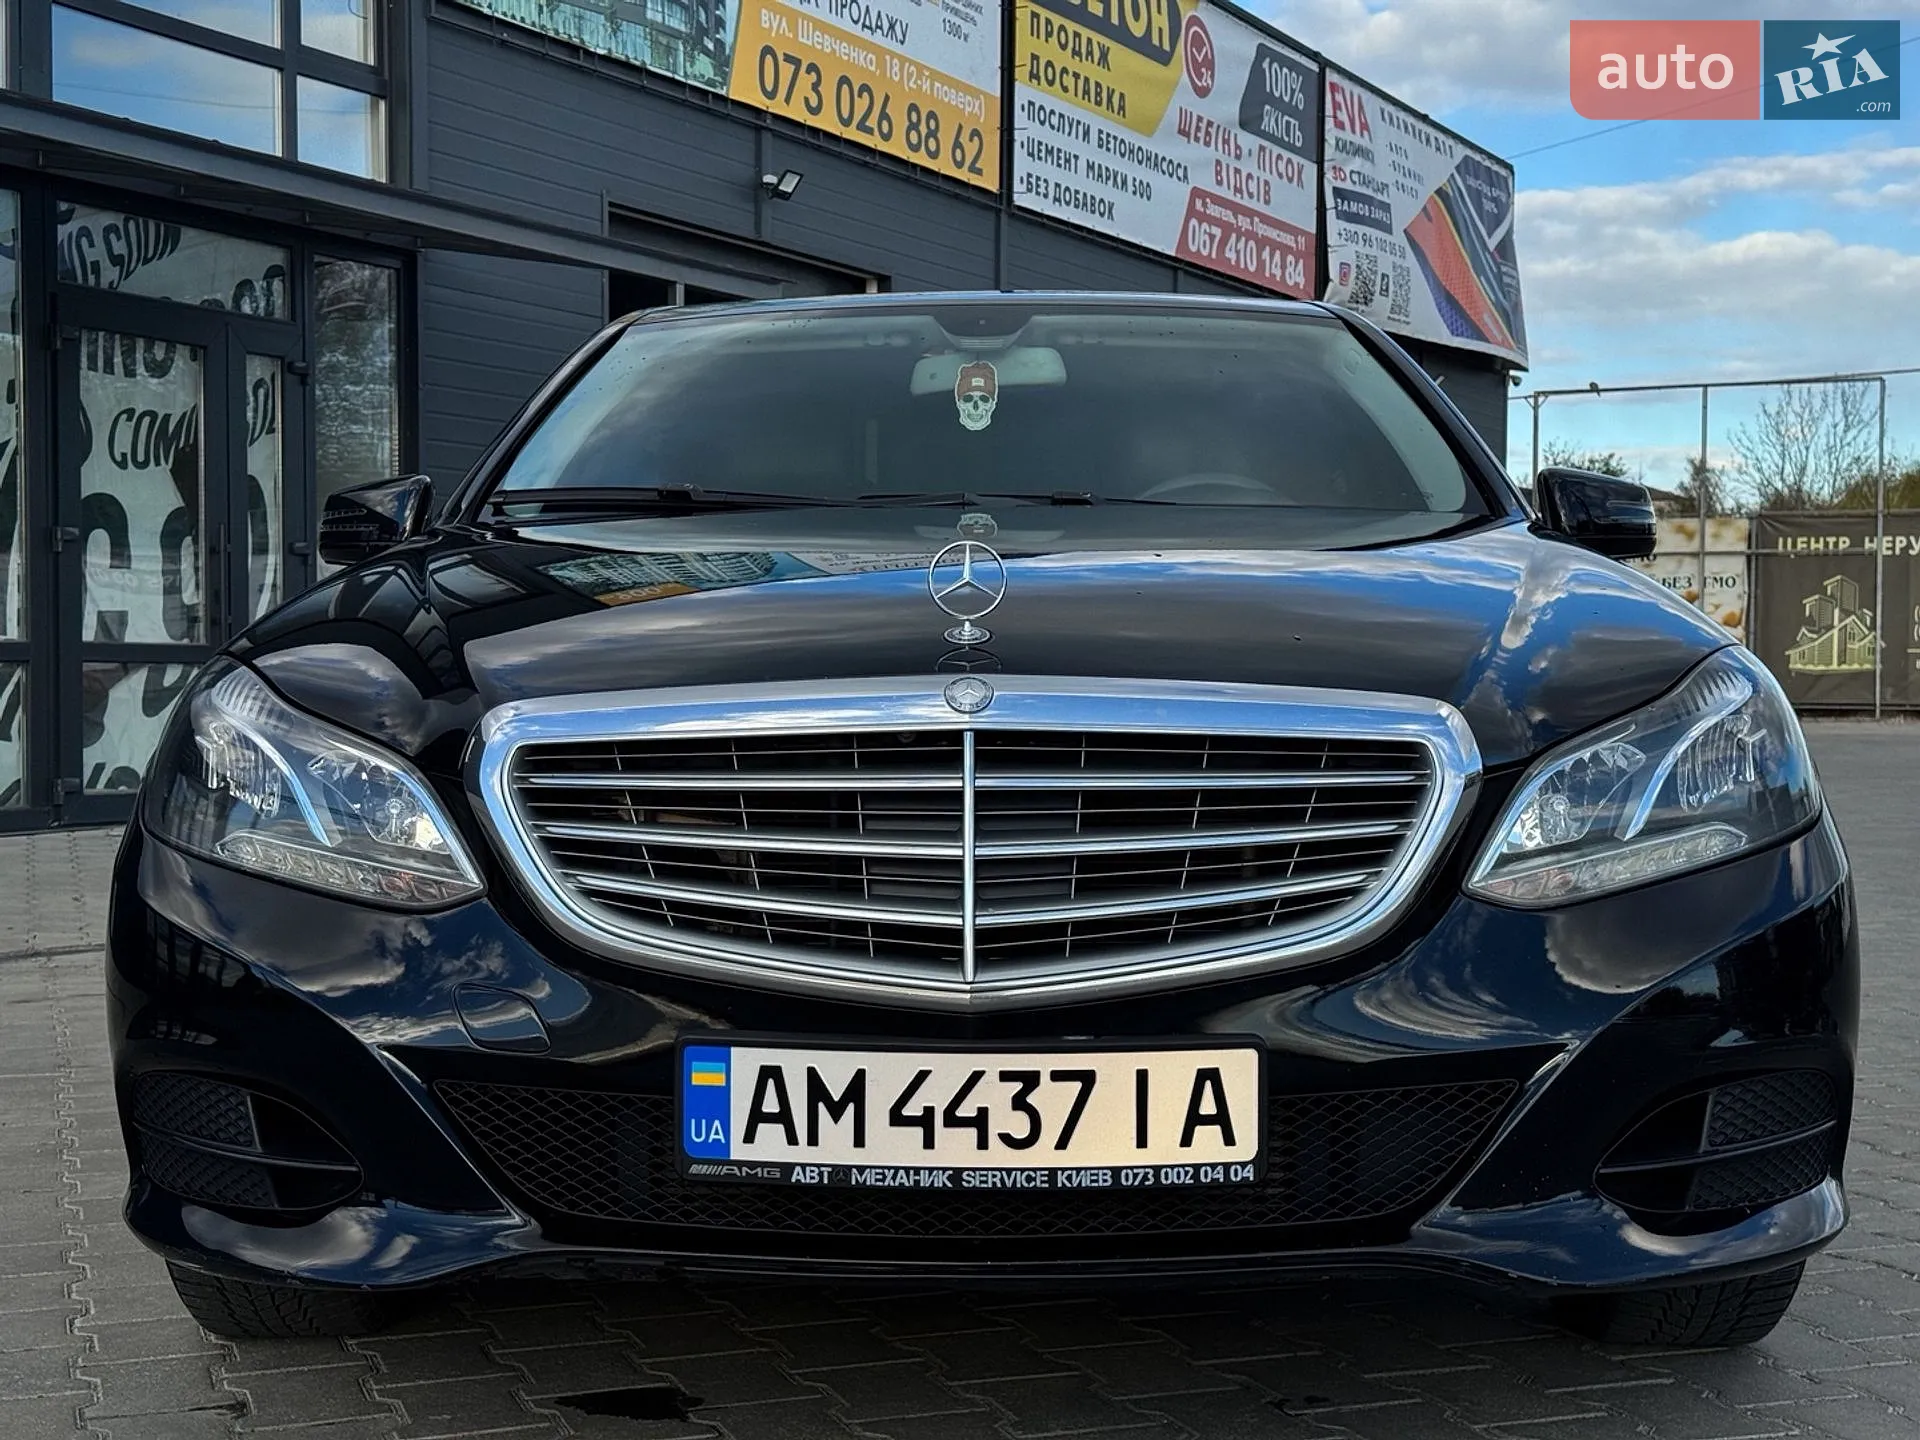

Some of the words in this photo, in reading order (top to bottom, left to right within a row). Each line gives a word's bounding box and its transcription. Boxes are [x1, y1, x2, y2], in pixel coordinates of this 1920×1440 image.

[761, 8, 793, 38] вул.
[798, 18, 880, 76] Шевченка,
[885, 54, 900, 82] 18
[903, 62, 931, 96] (2-й
[933, 81, 985, 123] поверх)
[1030, 10, 1112, 73] ПРОДАЖ
[1028, 52, 1127, 119] ДОСТАВКА
[1200, 67, 1212, 89] 24
[1261, 56, 1305, 111] 100%
[758, 44, 823, 116] 073
[835, 74, 893, 142] 026
[905, 102, 941, 160] 88
[951, 122, 984, 177] 62
[1027, 99, 1091, 145] ПОСЛУГИ
[1097, 128, 1190, 185] БЕТОНОНАСОСА
[1261, 103, 1304, 149] ЯКІСТЬ
[1328, 81, 1373, 144] EVA
[1026, 135, 1080, 175] ЦЕМЕНТ
[1086, 158, 1128, 193] МАРКИ
[1131, 177, 1153, 203] 500
[1177, 105, 1243, 162] ЩЕБІНЬ
[1257, 143, 1305, 190] ПІСОК
[1025, 171, 1050, 200] БЕЗ
[1052, 181, 1116, 221] ДОБАВОК
[1214, 158, 1272, 206] ВІДСІВ
[1187, 217, 1222, 259] 067
[1225, 232, 1257, 273] 410
[1261, 245, 1282, 281] 14
[1285, 254, 1306, 290] 84
[1777, 535, 1851, 558] ЦЕНТР
[690, 1118, 726, 1144] UA
[742, 1064, 867, 1148] AM
[888, 1069, 1097, 1150] 4437
[961, 1170, 1050, 1188] SERVICE
[1057, 1169, 1113, 1187] КИЕВ
[1120, 1168, 1155, 1187] 073
[1160, 1167, 1195, 1185] 002
[1200, 1165, 1224, 1183] 04
[1229, 1163, 1255, 1182] 04
